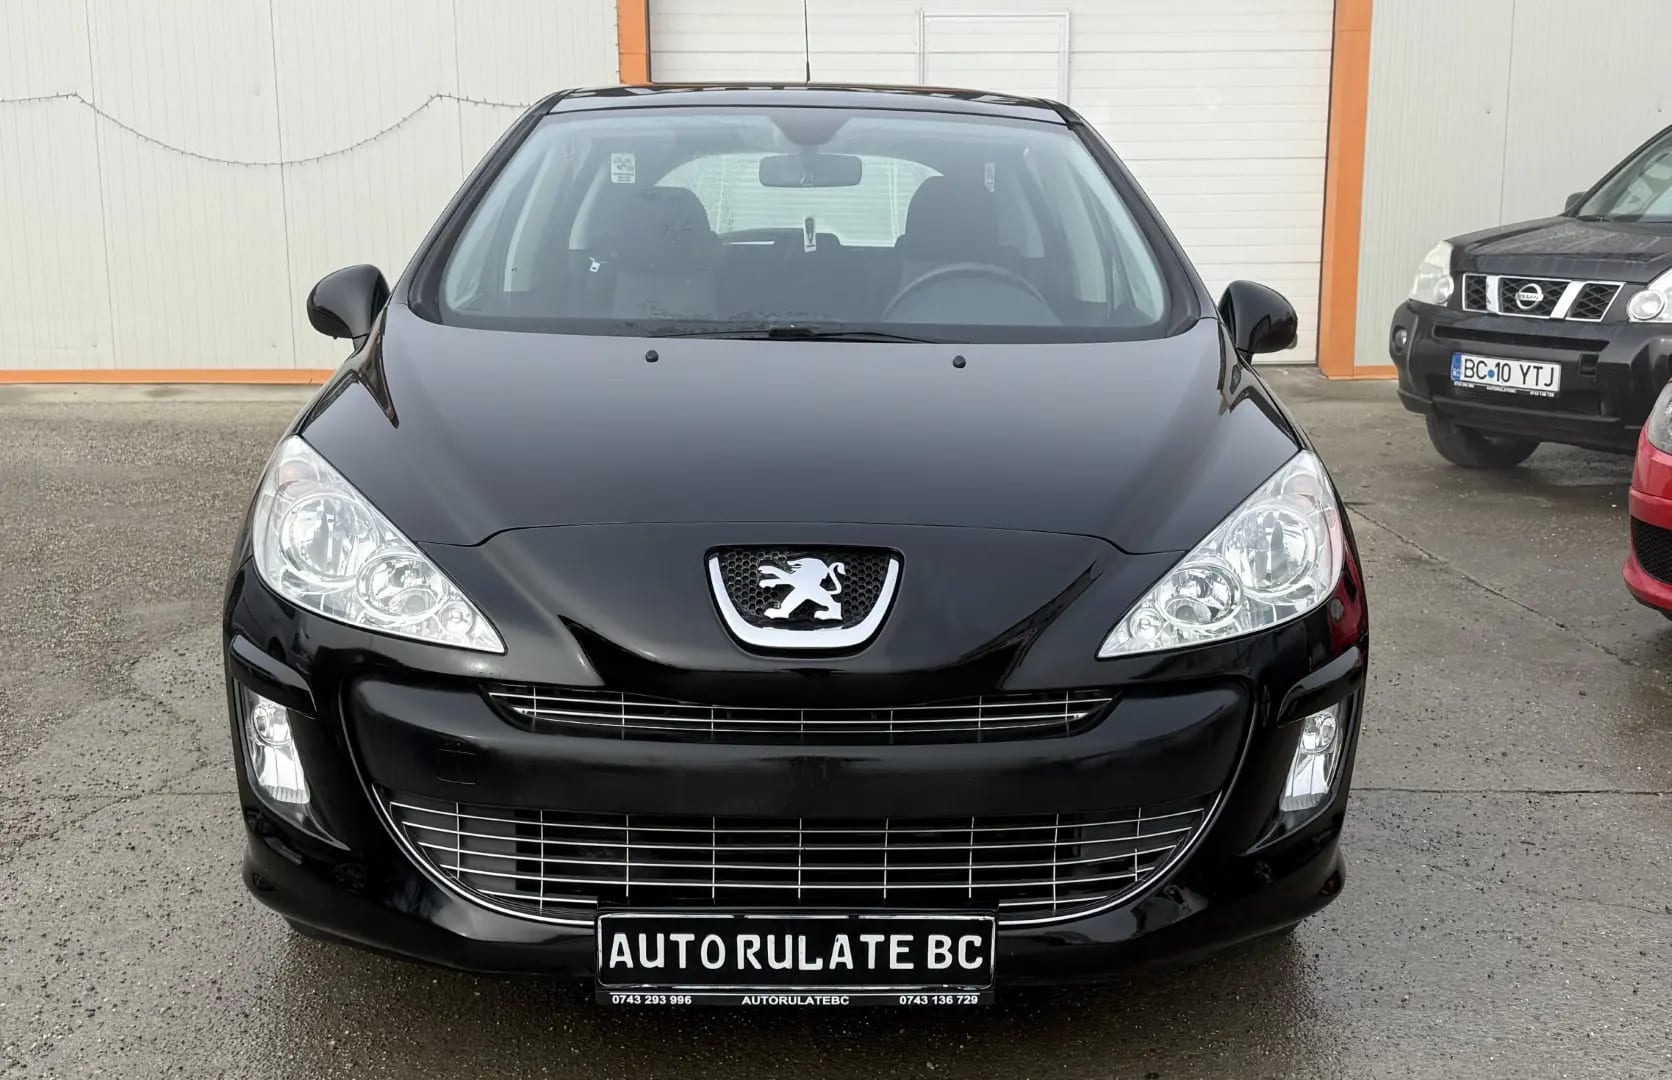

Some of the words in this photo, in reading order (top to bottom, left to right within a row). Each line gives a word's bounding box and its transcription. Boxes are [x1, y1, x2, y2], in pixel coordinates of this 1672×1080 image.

[1464, 358, 1488, 380] BC
[1495, 362, 1512, 383] 10
[1519, 363, 1554, 387] YTJ
[609, 933, 726, 970] AUTO
[736, 934, 915, 971] RULATE
[927, 934, 983, 971] BC
[611, 994, 642, 1005] 0743
[644, 994, 667, 1005] 293
[669, 995, 692, 1005] 996
[741, 994, 850, 1006] AUTORULATEBC
[899, 995, 929, 1005] 0743
[931, 995, 954, 1005] 136
[956, 995, 979, 1005] 729
